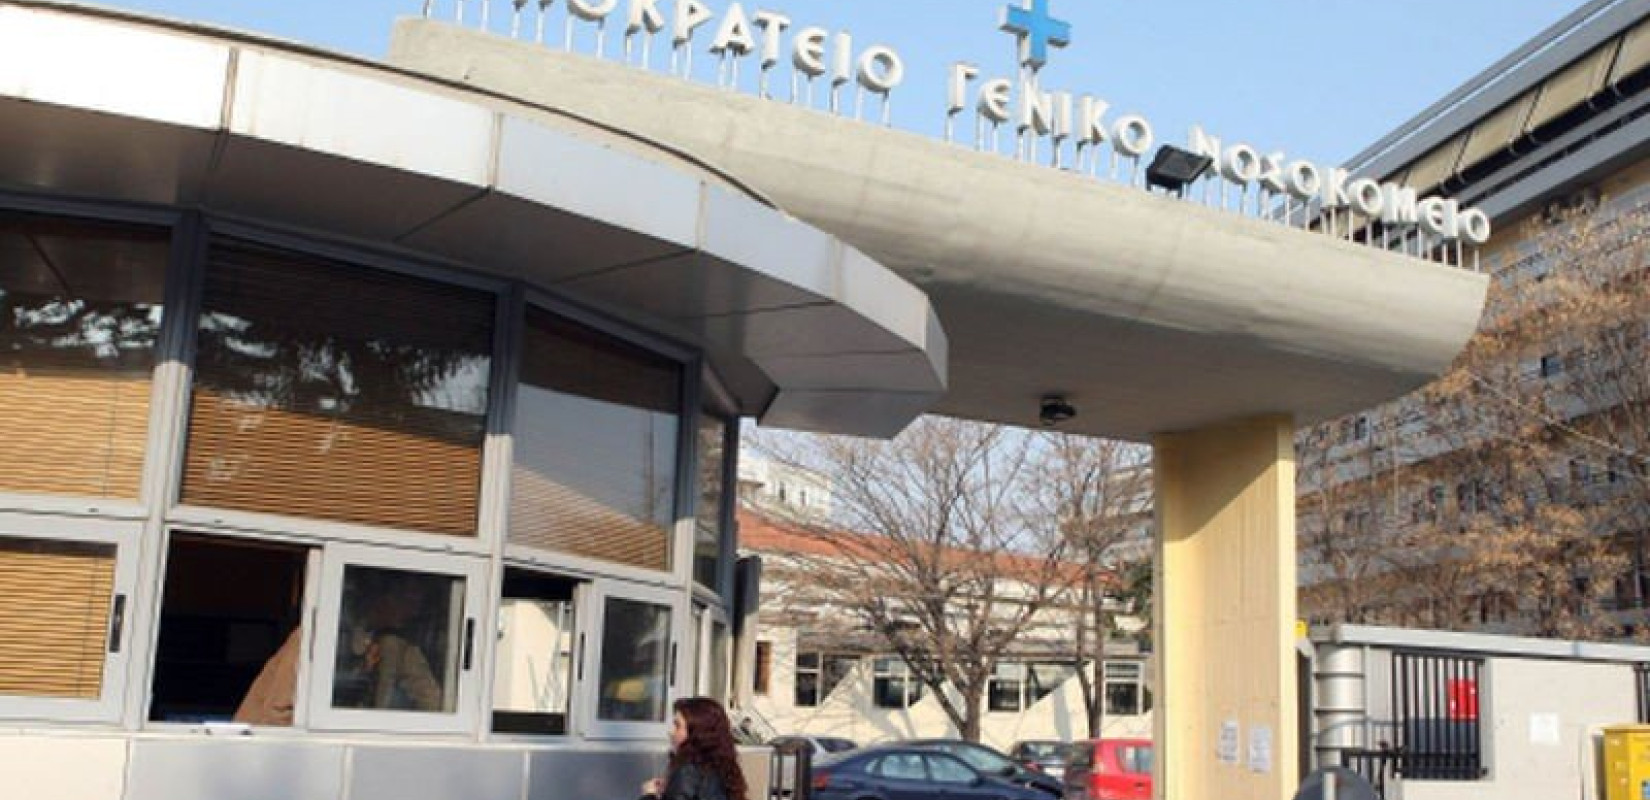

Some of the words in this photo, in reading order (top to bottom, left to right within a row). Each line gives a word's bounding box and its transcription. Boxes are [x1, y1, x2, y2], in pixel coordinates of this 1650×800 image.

[512, 0, 904, 94] ΚΡΑΤΕΙΟ
[946, 60, 1154, 158] ΓΕΝΙΚΟ
[1187, 124, 1491, 244] ΝΟΣΟΚΟΜΕΙΟ
